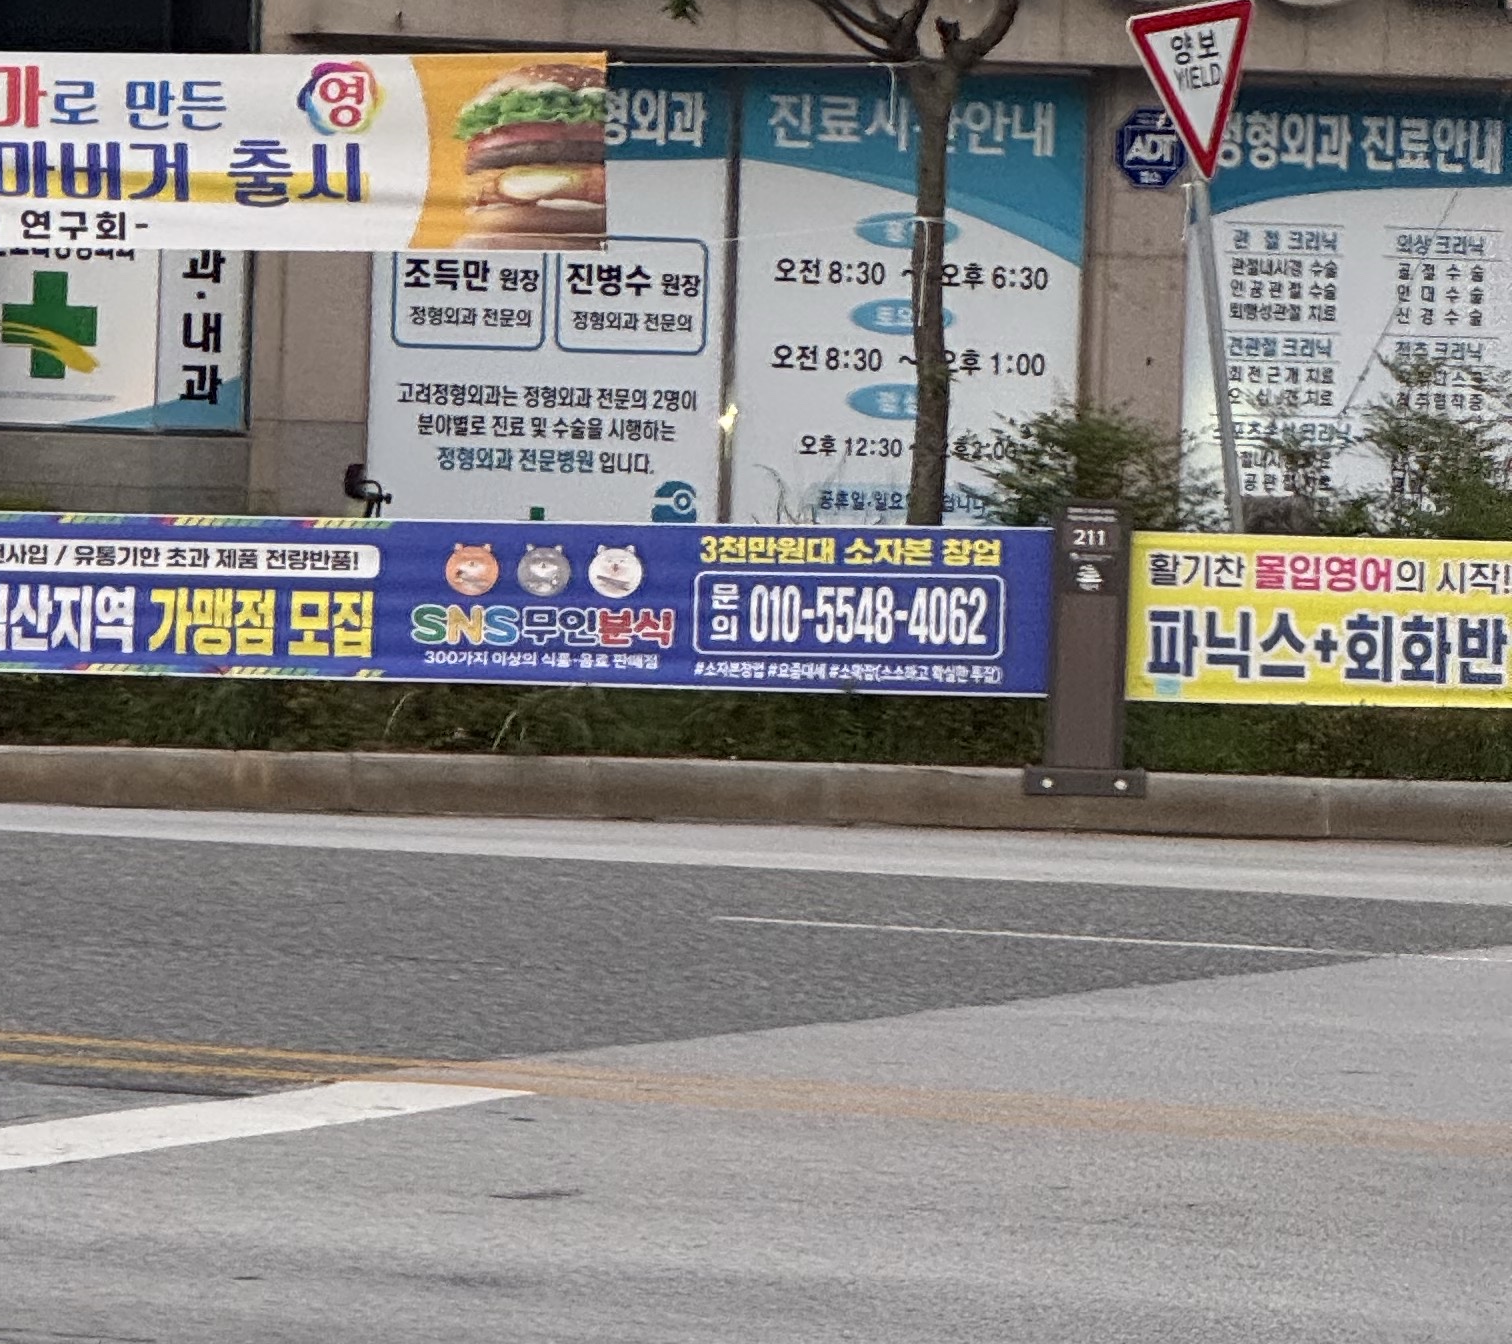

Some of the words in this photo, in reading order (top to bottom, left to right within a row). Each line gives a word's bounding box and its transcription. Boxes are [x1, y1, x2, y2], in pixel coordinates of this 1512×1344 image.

[1170, 29, 1219, 65] 양보
[1174, 63, 1223, 90] YIELD
[125, 79, 228, 132] 만든
[320, 71, 369, 129] 영
[767, 91, 1057, 157] 진료시안내
[1124, 133, 1178, 164] ADT
[1360, 115, 1506, 175] 진료안내
[226, 139, 364, 207] 출시
[403, 258, 490, 293] 조득만
[499, 267, 539, 293] 원장
[565, 262, 652, 297] 진병수
[660, 273, 701, 298] 원장
[773, 257, 821, 285] 오전
[828, 260, 886, 286] 8:30
[941, 262, 985, 290] 오후
[991, 266, 1049, 290] 6:30
[1310, 259, 1338, 279] 수술
[1309, 281, 1337, 301] 수술
[408, 306, 478, 327] 정형외과
[483, 309, 532, 329] 전문의
[571, 310, 639, 332] 정형외과
[643, 312, 693, 333] 전문의
[770, 344, 820, 373] 오전
[826, 346, 883, 373] 8:30
[990, 352, 1046, 377] 1:00
[397, 383, 518, 407] 고려정형외과는
[523, 385, 592, 408] 정형외과
[596, 388, 647, 410] 전문의
[652, 389, 698, 412] 2명이
[417, 413, 486, 437] 분야별로
[491, 415, 525, 437] 진료
[531, 417, 547, 439] 및
[553, 418, 603, 440] 수술을
[608, 419, 676, 442] 시행하는
[438, 446, 512, 472] 정형외과
[519, 447, 595, 473] 전문병원
[599, 450, 655, 475] 입니다.
[798, 434, 838, 456] 오후
[845, 436, 903, 458] 12:30
[699, 534, 836, 565] 3천만원대
[843, 536, 934, 567] 소자본
[941, 538, 1002, 568] 창업
[1072, 529, 1106, 546] 211
[74, 545, 161, 568] 유통기한
[166, 548, 211, 569] 초과
[216, 548, 259, 570] 제품
[265, 549, 360, 572] 전량반품!
[1148, 551, 1246, 588] 활기찬
[1254, 553, 1426, 594] 몰입영어의
[148, 586, 277, 657] 가맹점
[288, 589, 376, 659] 모집
[410, 603, 677, 649] SNS무인분식
[710, 583, 741, 643] 문의
[748, 584, 989, 646] 010-5548-4062
[424, 649, 488, 667] 300가지
[491, 649, 538, 668] 이상의
